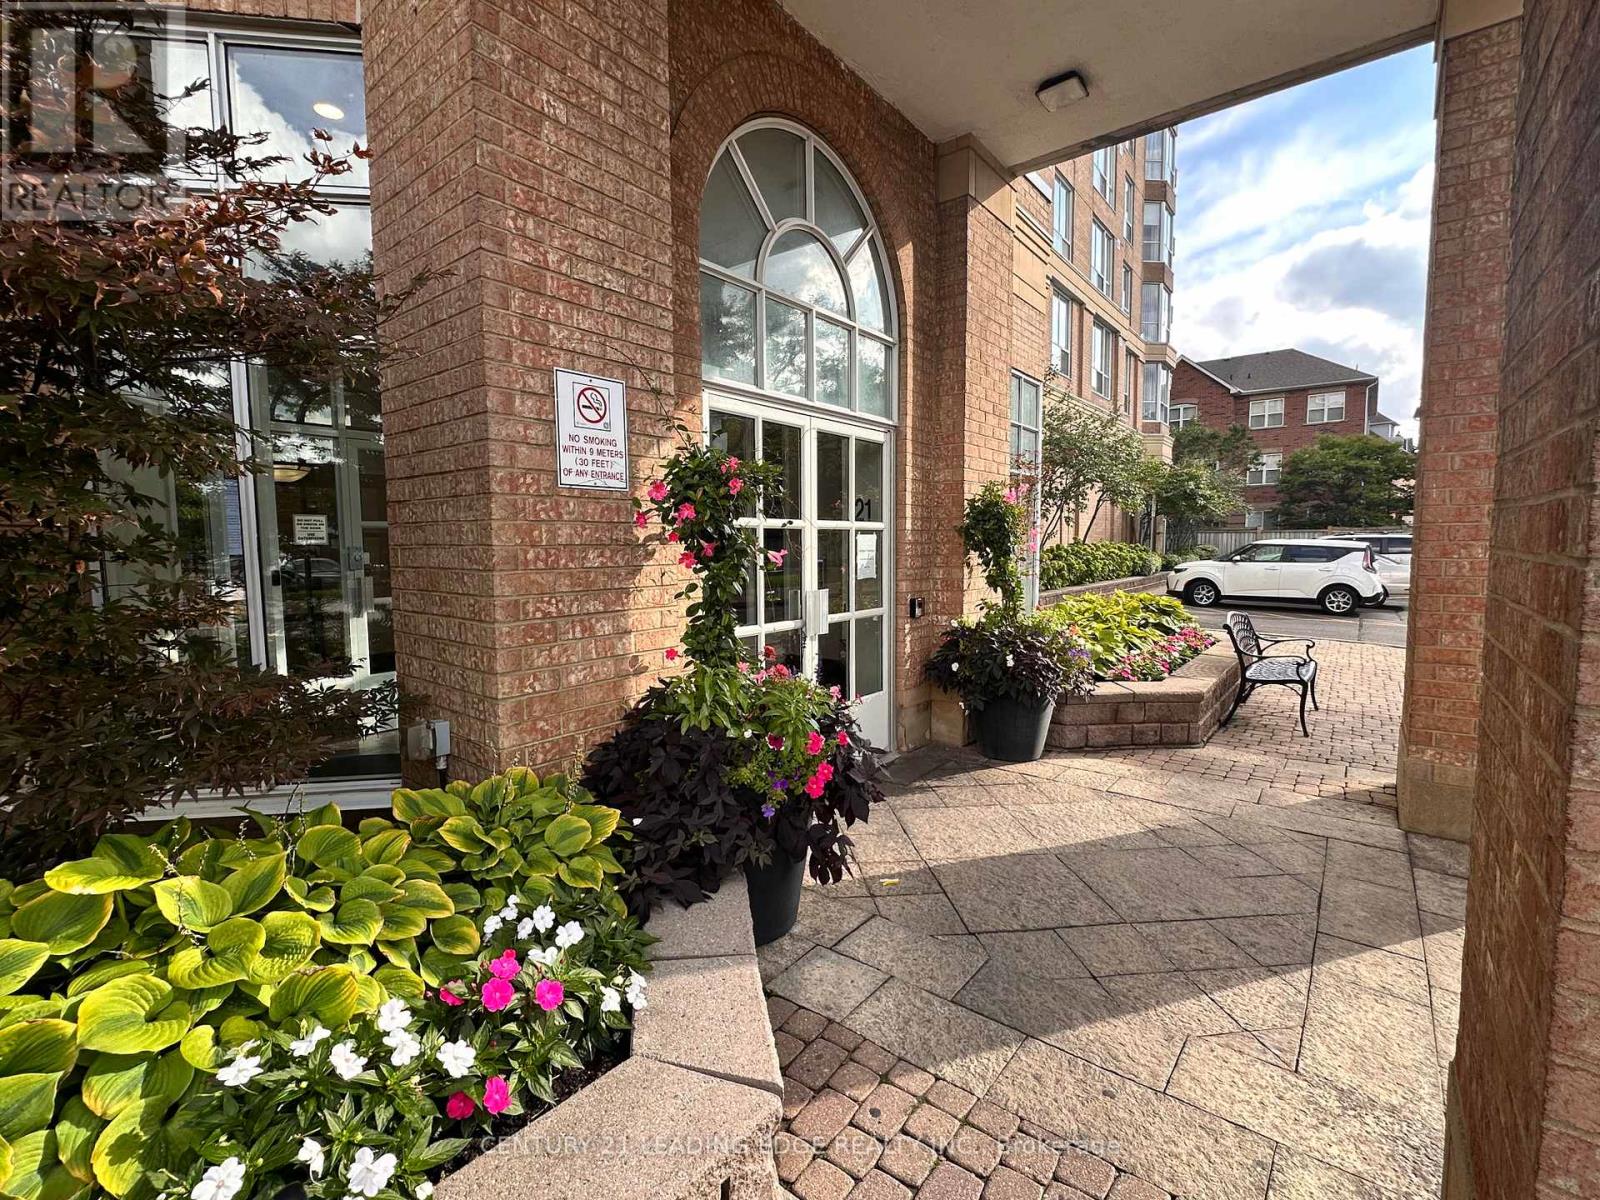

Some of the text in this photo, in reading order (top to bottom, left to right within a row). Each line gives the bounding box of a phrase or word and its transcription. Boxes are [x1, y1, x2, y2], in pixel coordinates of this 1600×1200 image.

[568, 434, 617, 447] NO SMOKING
[562, 445, 587, 454] WITHIN
[596, 449, 624, 459] METERS
[575, 457, 613, 468] (30 FEET)
[563, 468, 573, 476] OF
[591, 470, 624, 480] ENTRANCE
[855, 498, 871, 521] 21
